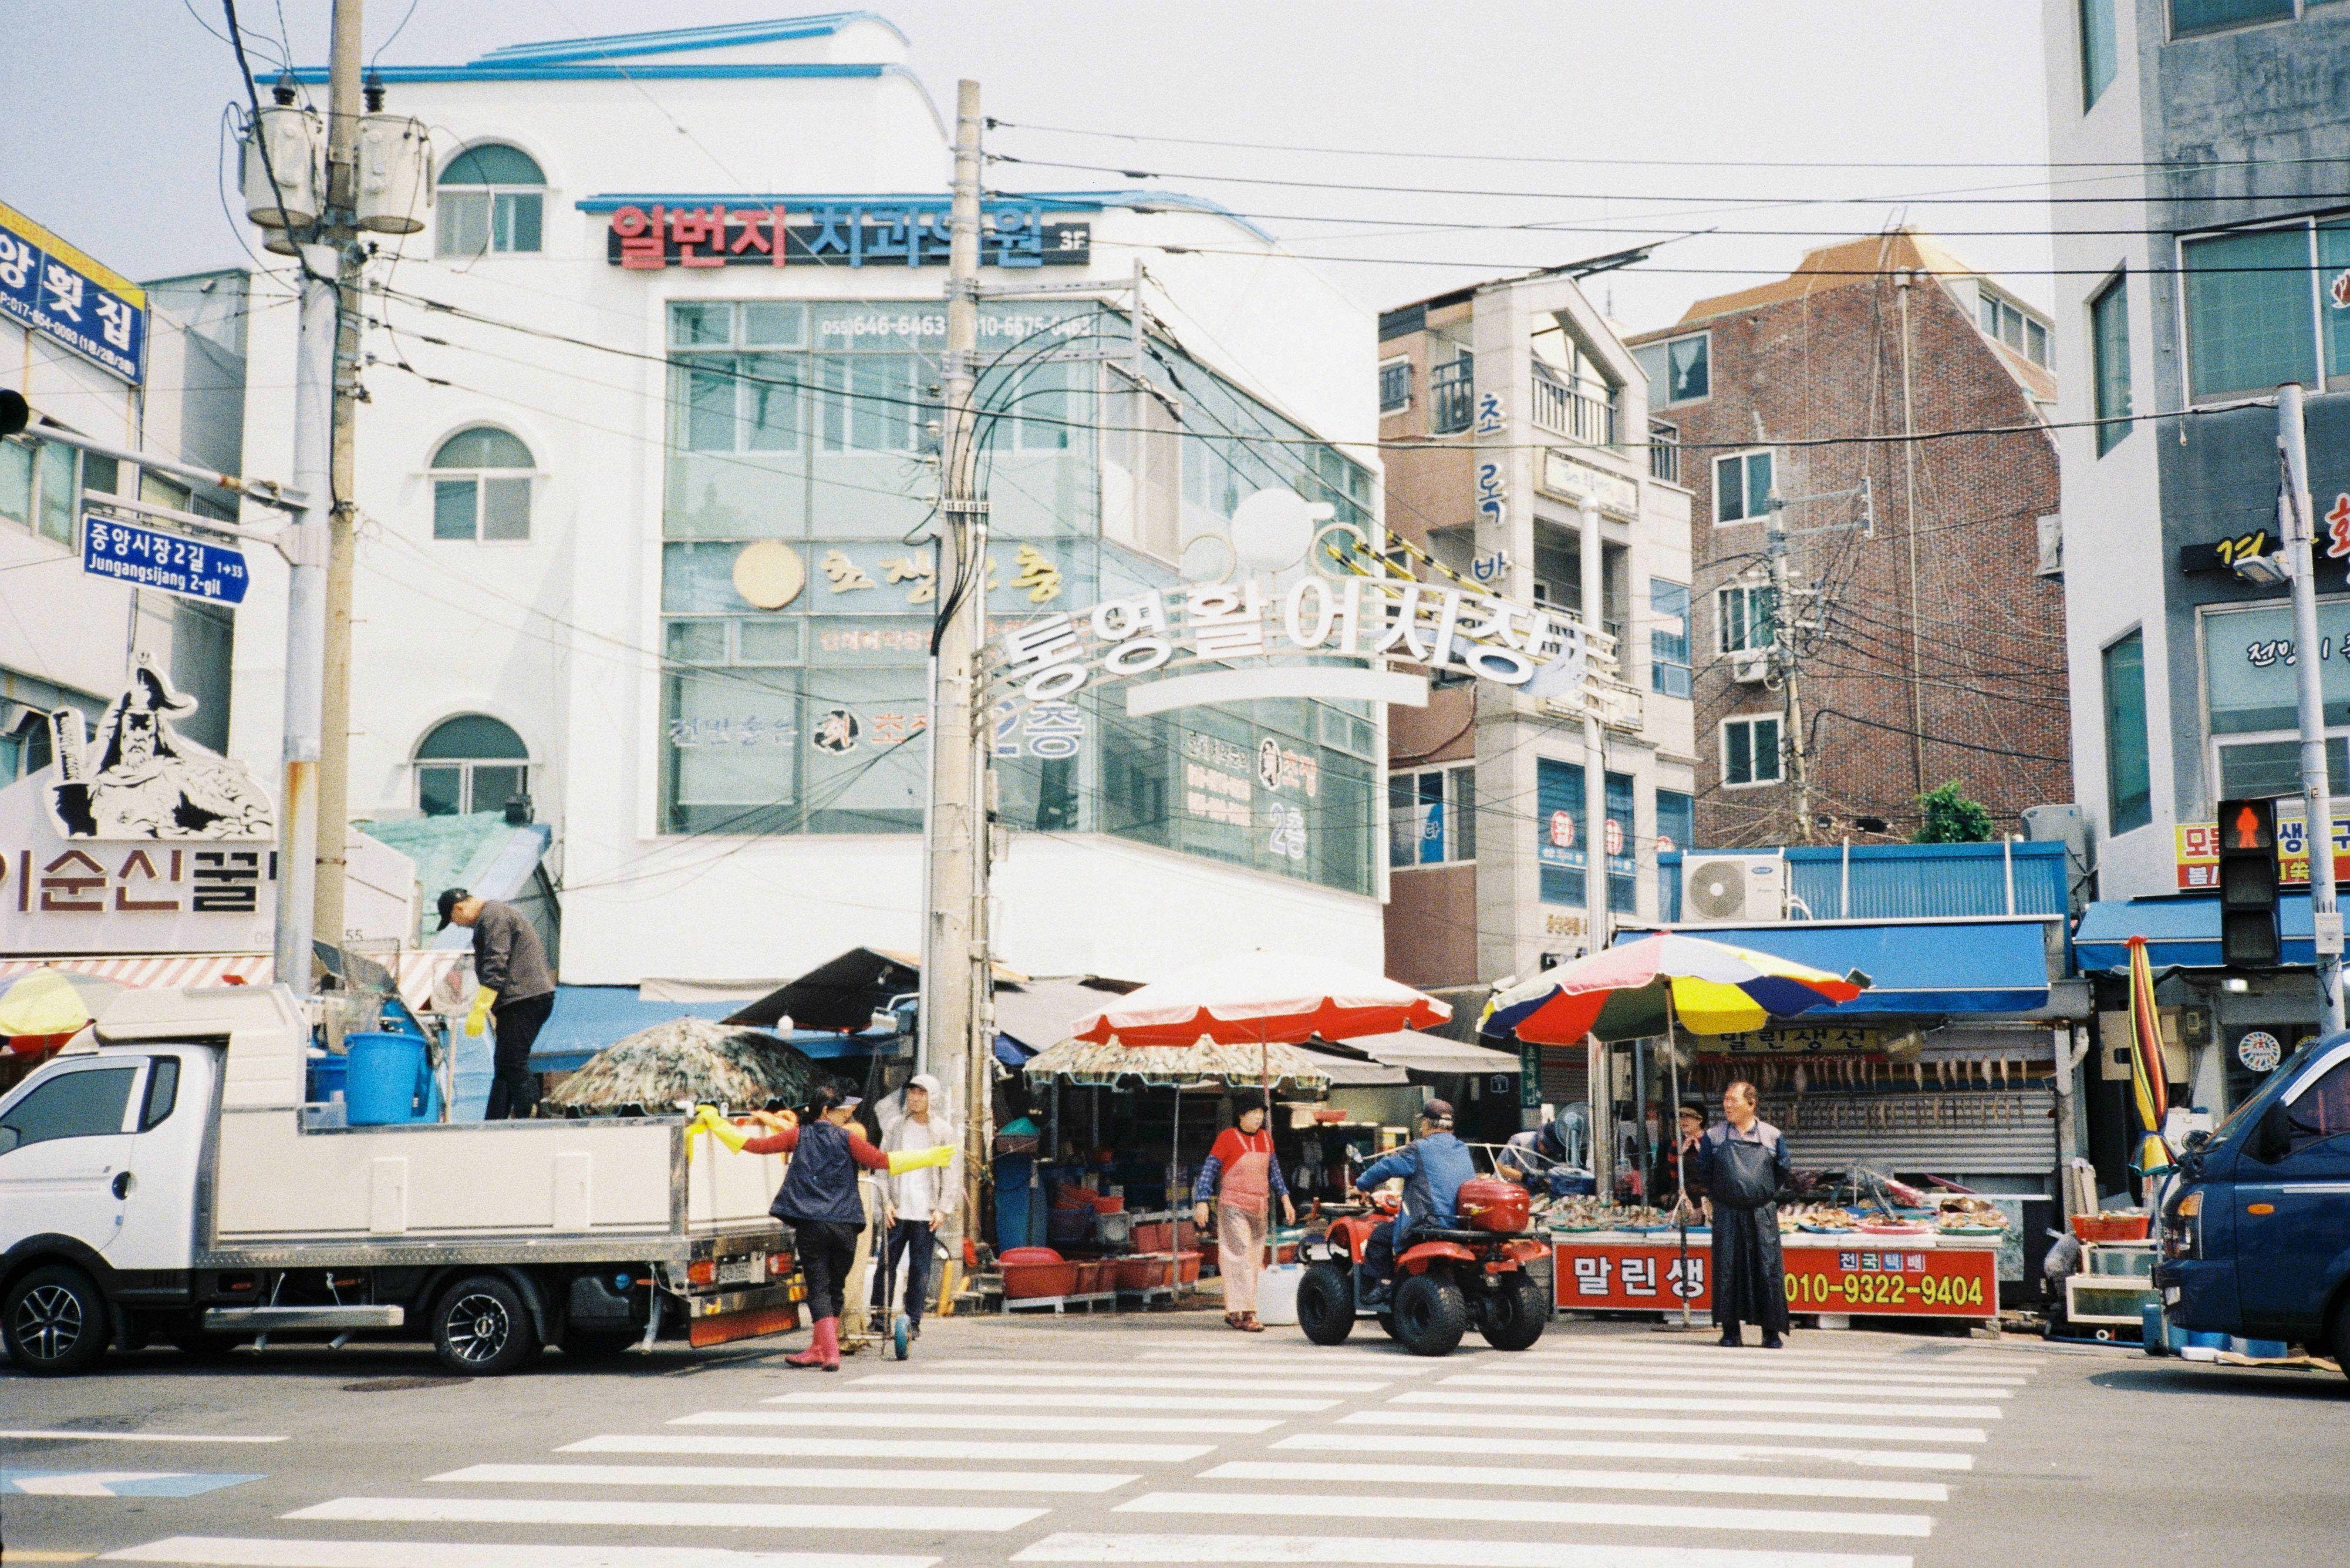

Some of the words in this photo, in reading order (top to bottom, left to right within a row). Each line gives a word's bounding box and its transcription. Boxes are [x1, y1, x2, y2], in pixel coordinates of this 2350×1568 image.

[611, 204, 785, 269] 일번지
[1059, 230, 1085, 250] 3F
[90, 522, 205, 573] 중앙시장2길
[89, 553, 185, 591] Jungangsijang
[190, 574, 221, 596] 2-gil
[1004, 575, 1554, 702] 통영활어시장
[1269, 802, 1306, 860] 2층
[1720, 1028, 1865, 1050] 말린생선
[1838, 1251, 1926, 1272] 전국택배
[1784, 1272, 1983, 1306] 010-9322-9404
